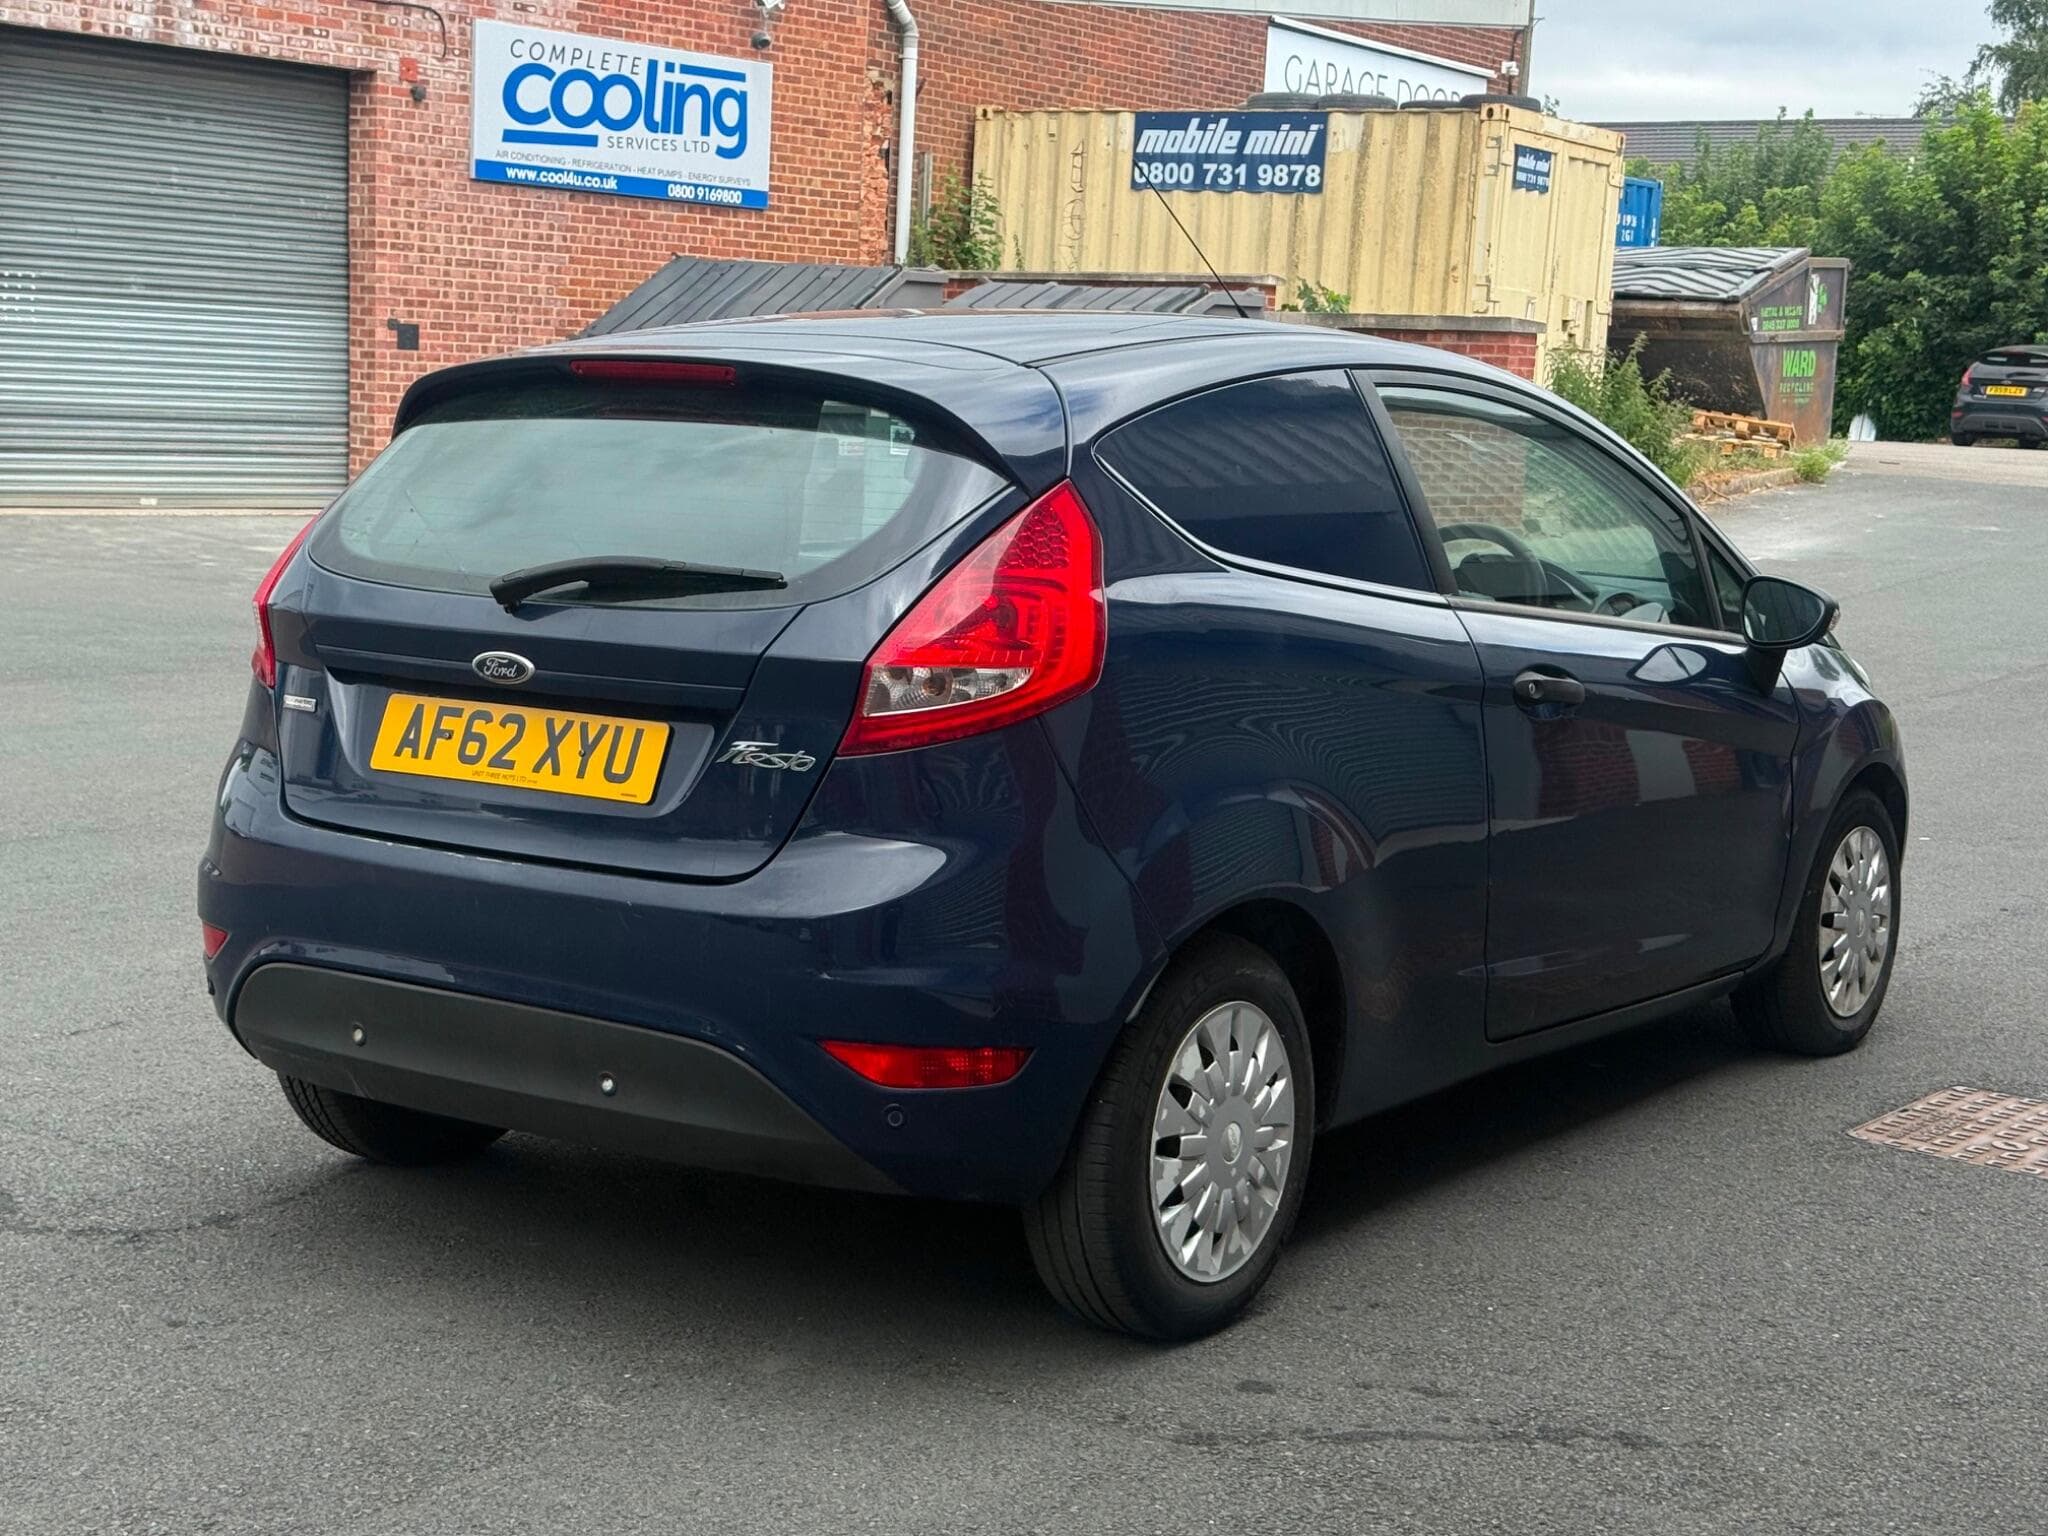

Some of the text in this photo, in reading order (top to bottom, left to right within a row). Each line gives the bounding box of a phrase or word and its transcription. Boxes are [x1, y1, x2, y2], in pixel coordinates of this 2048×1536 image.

[510, 39, 642, 76] COMPLETE
[1285, 55, 1461, 102] GARAGE DO
[502, 58, 748, 160] cooling
[607, 135, 711, 154] SERVICES LTD
[1136, 117, 1320, 155] mobile mini
[495, 149, 751, 187] AIR CONDITIONING REFRIGERATION HEAT PUMPS ENERGY SURVEYS
[505, 166, 618, 190] www.cool4u.co.uk
[1133, 161, 1321, 187] 0800 731 9878
[667, 183, 743, 204] 0800 9169800
[1782, 349, 1817, 378] WARD
[483, 657, 518, 678] Ford
[393, 703, 646, 784] AF62 XYU
[715, 740, 817, 772] Fiesta
